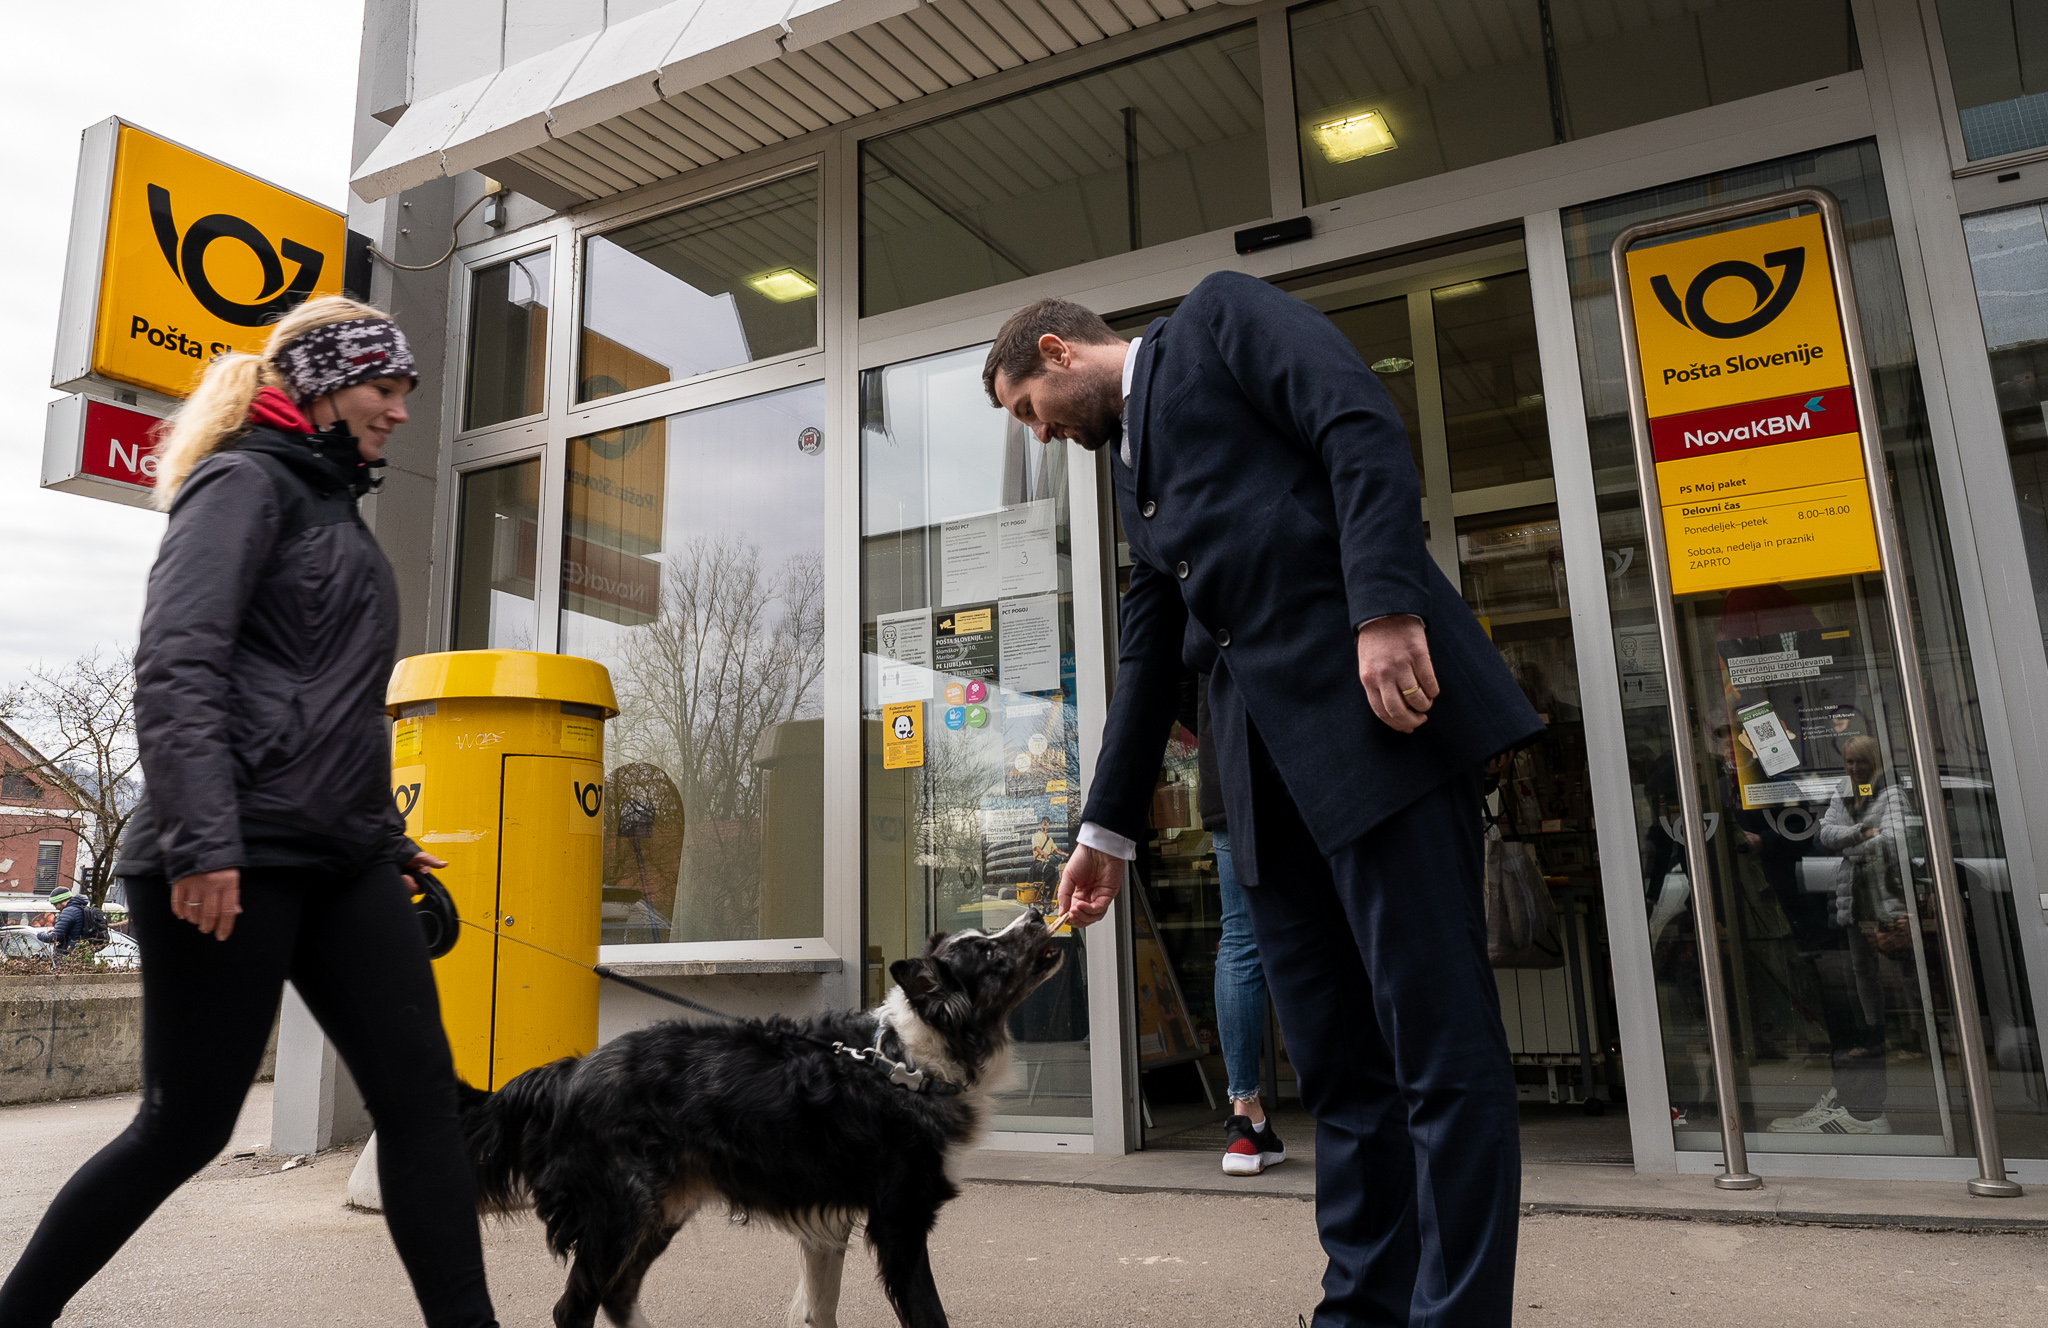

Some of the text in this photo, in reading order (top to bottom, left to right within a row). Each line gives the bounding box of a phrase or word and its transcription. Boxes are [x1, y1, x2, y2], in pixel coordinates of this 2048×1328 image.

[130, 315, 203, 360] Pošta
[1662, 343, 1824, 385] Pošta Slovenije
[1683, 412, 1811, 448] NovaKBM
[1679, 477, 1747, 495] PS Moj paket
[1682, 501, 1741, 517] Delovni čas
[1687, 533, 1815, 557] Sobota, nedelja in prazniki
[1689, 557, 1732, 570] ZAPRTO
[1729, 651, 1798, 666] Iščemo pomoč pri
[1731, 657, 1831, 677] preverjanju izpolnjevanja
[1732, 668, 1818, 684] PCT pogoja na poštah
